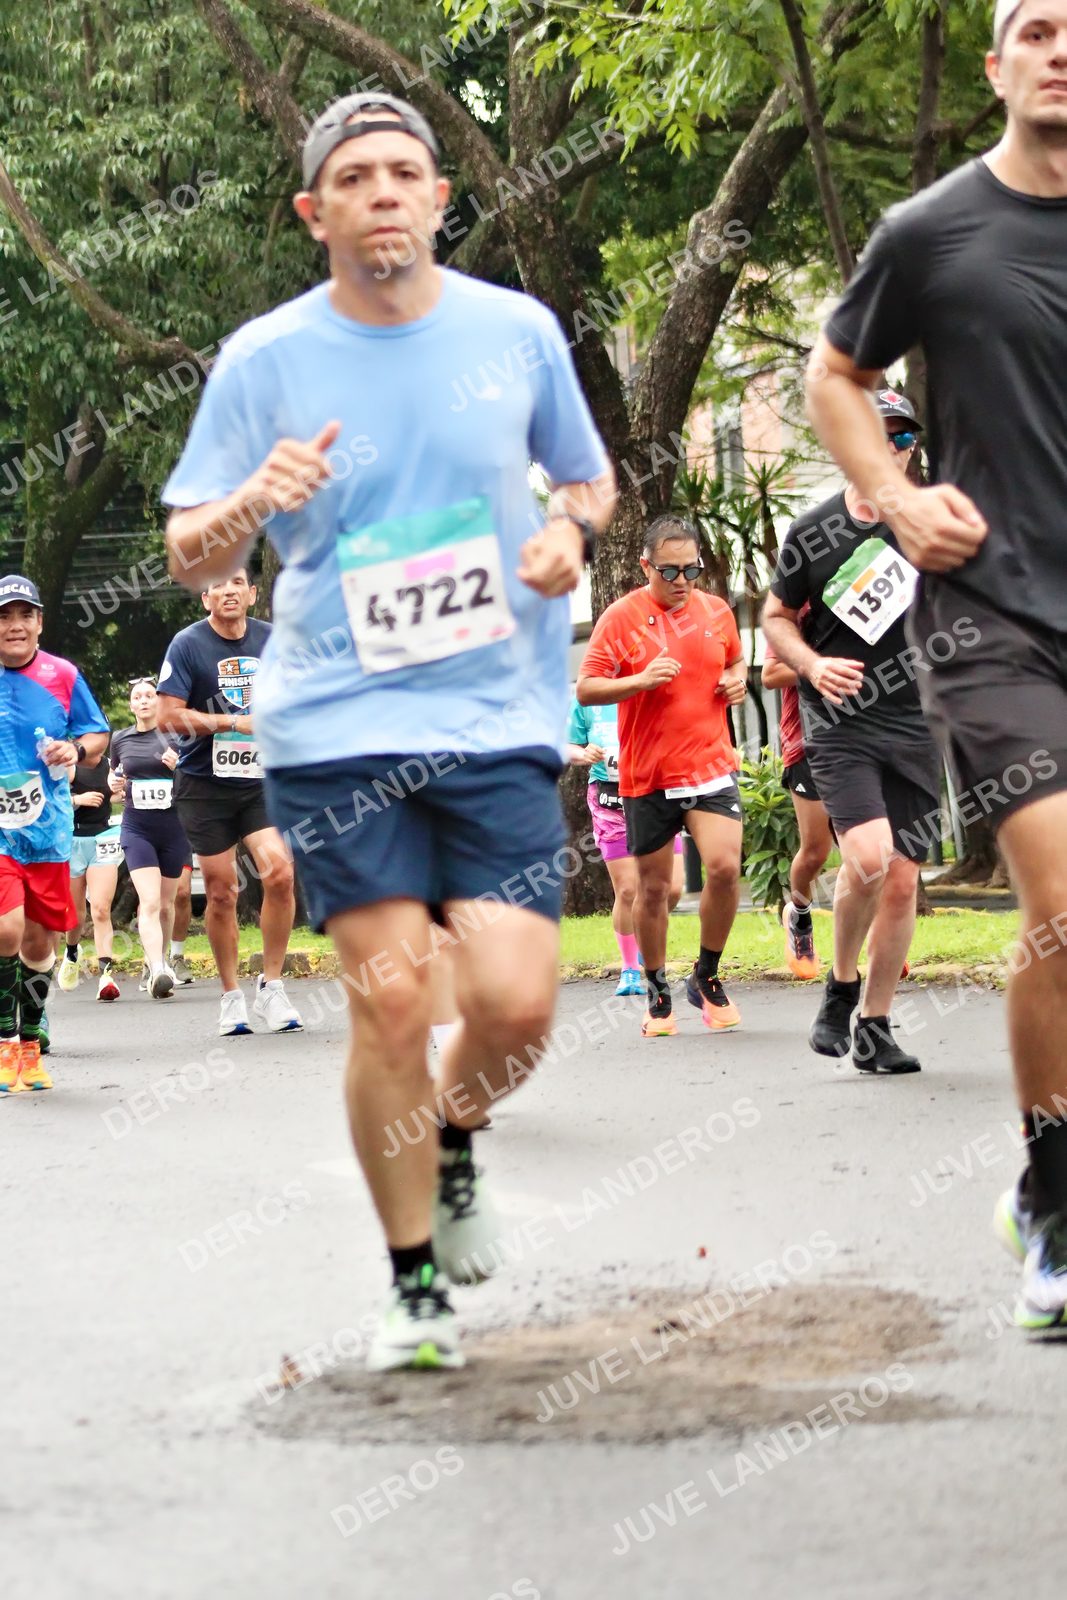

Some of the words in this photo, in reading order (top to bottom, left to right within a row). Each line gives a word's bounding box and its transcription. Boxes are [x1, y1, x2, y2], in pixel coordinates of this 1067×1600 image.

[0, 583, 32, 597] ECAL
[847, 560, 906, 624] 1397
[367, 567, 494, 632] 4722
[216, 750, 261, 766] 6064
[140, 789, 167, 801] 119
